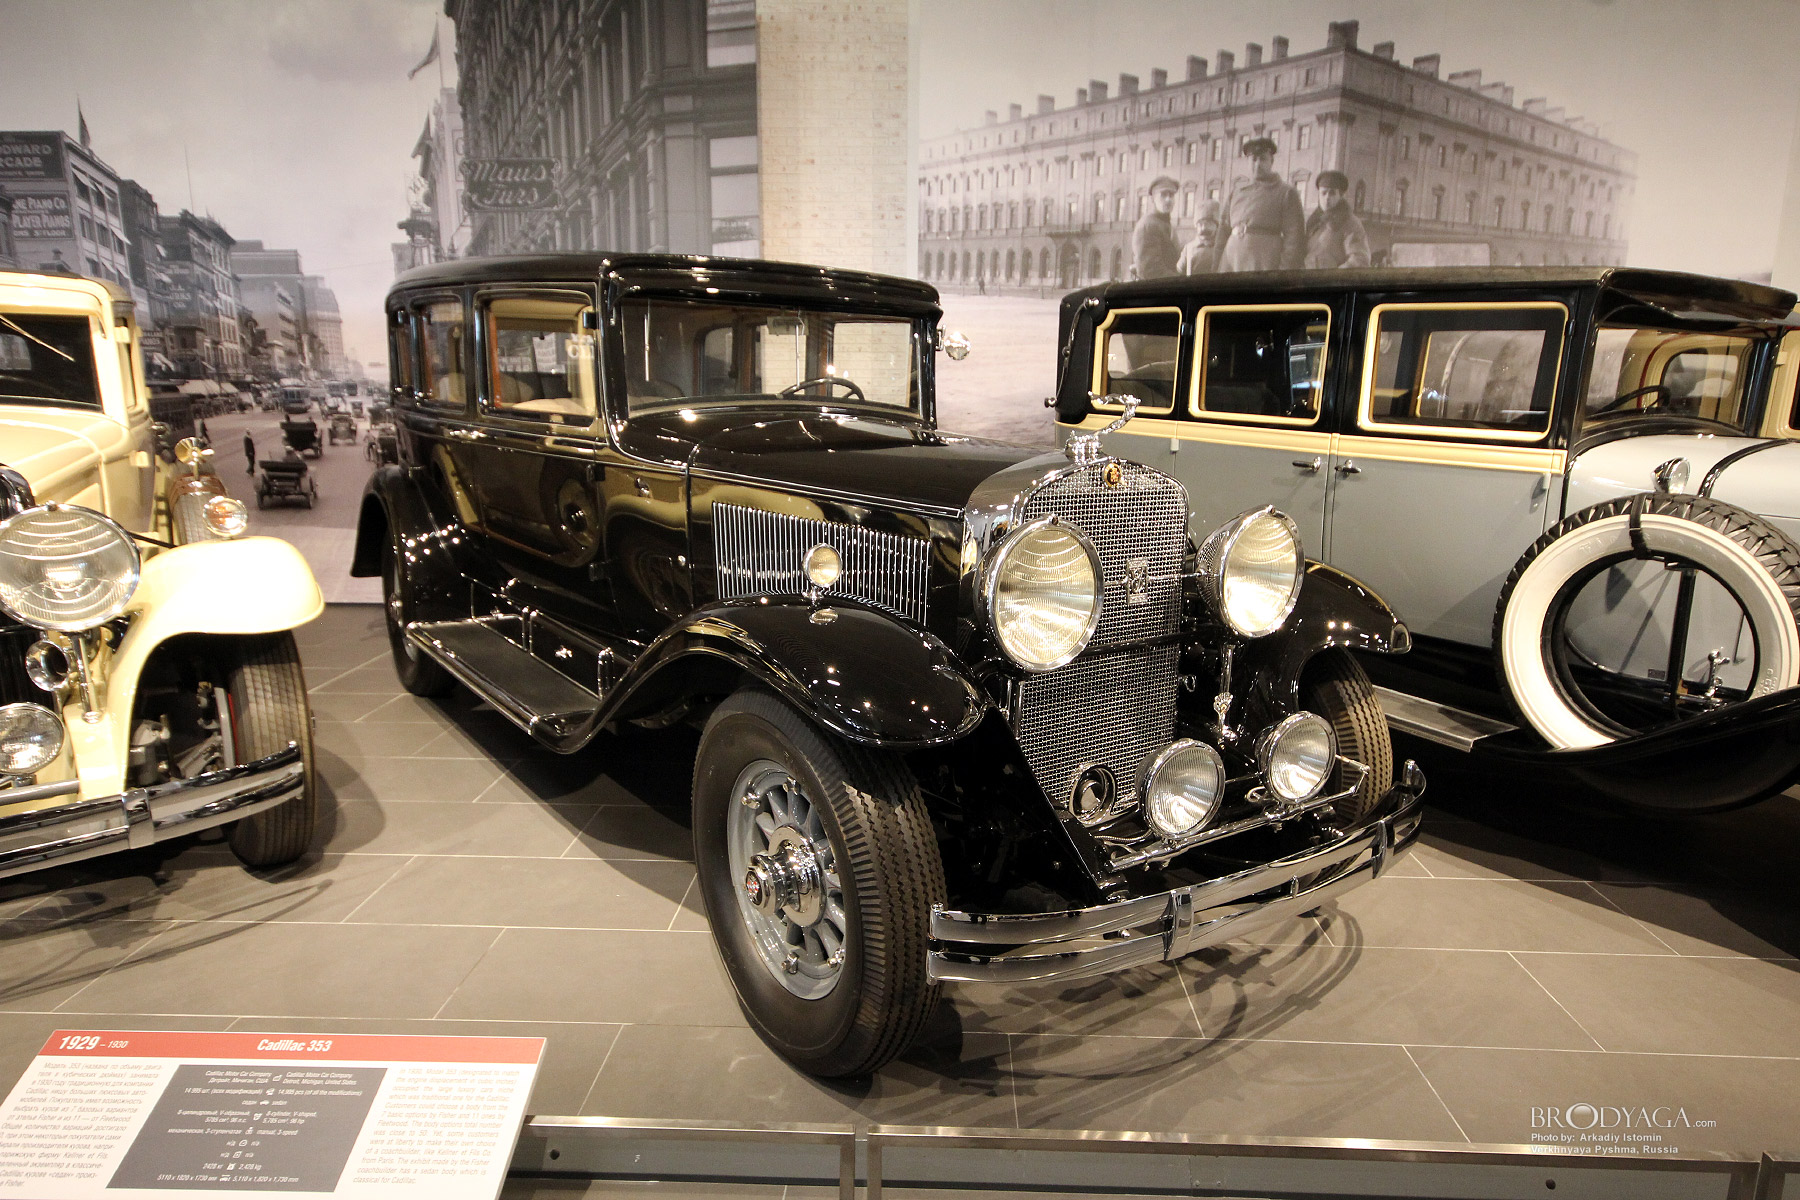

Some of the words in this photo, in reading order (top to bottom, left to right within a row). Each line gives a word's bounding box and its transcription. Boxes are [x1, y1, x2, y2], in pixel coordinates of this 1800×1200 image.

[27, 197, 53, 209] PIANO
[12, 214, 41, 228] PLAYER
[59, 1036, 100, 1050] 1929
[257, 1039, 305, 1051] Cadillac
[307, 1040, 332, 1052] 353
